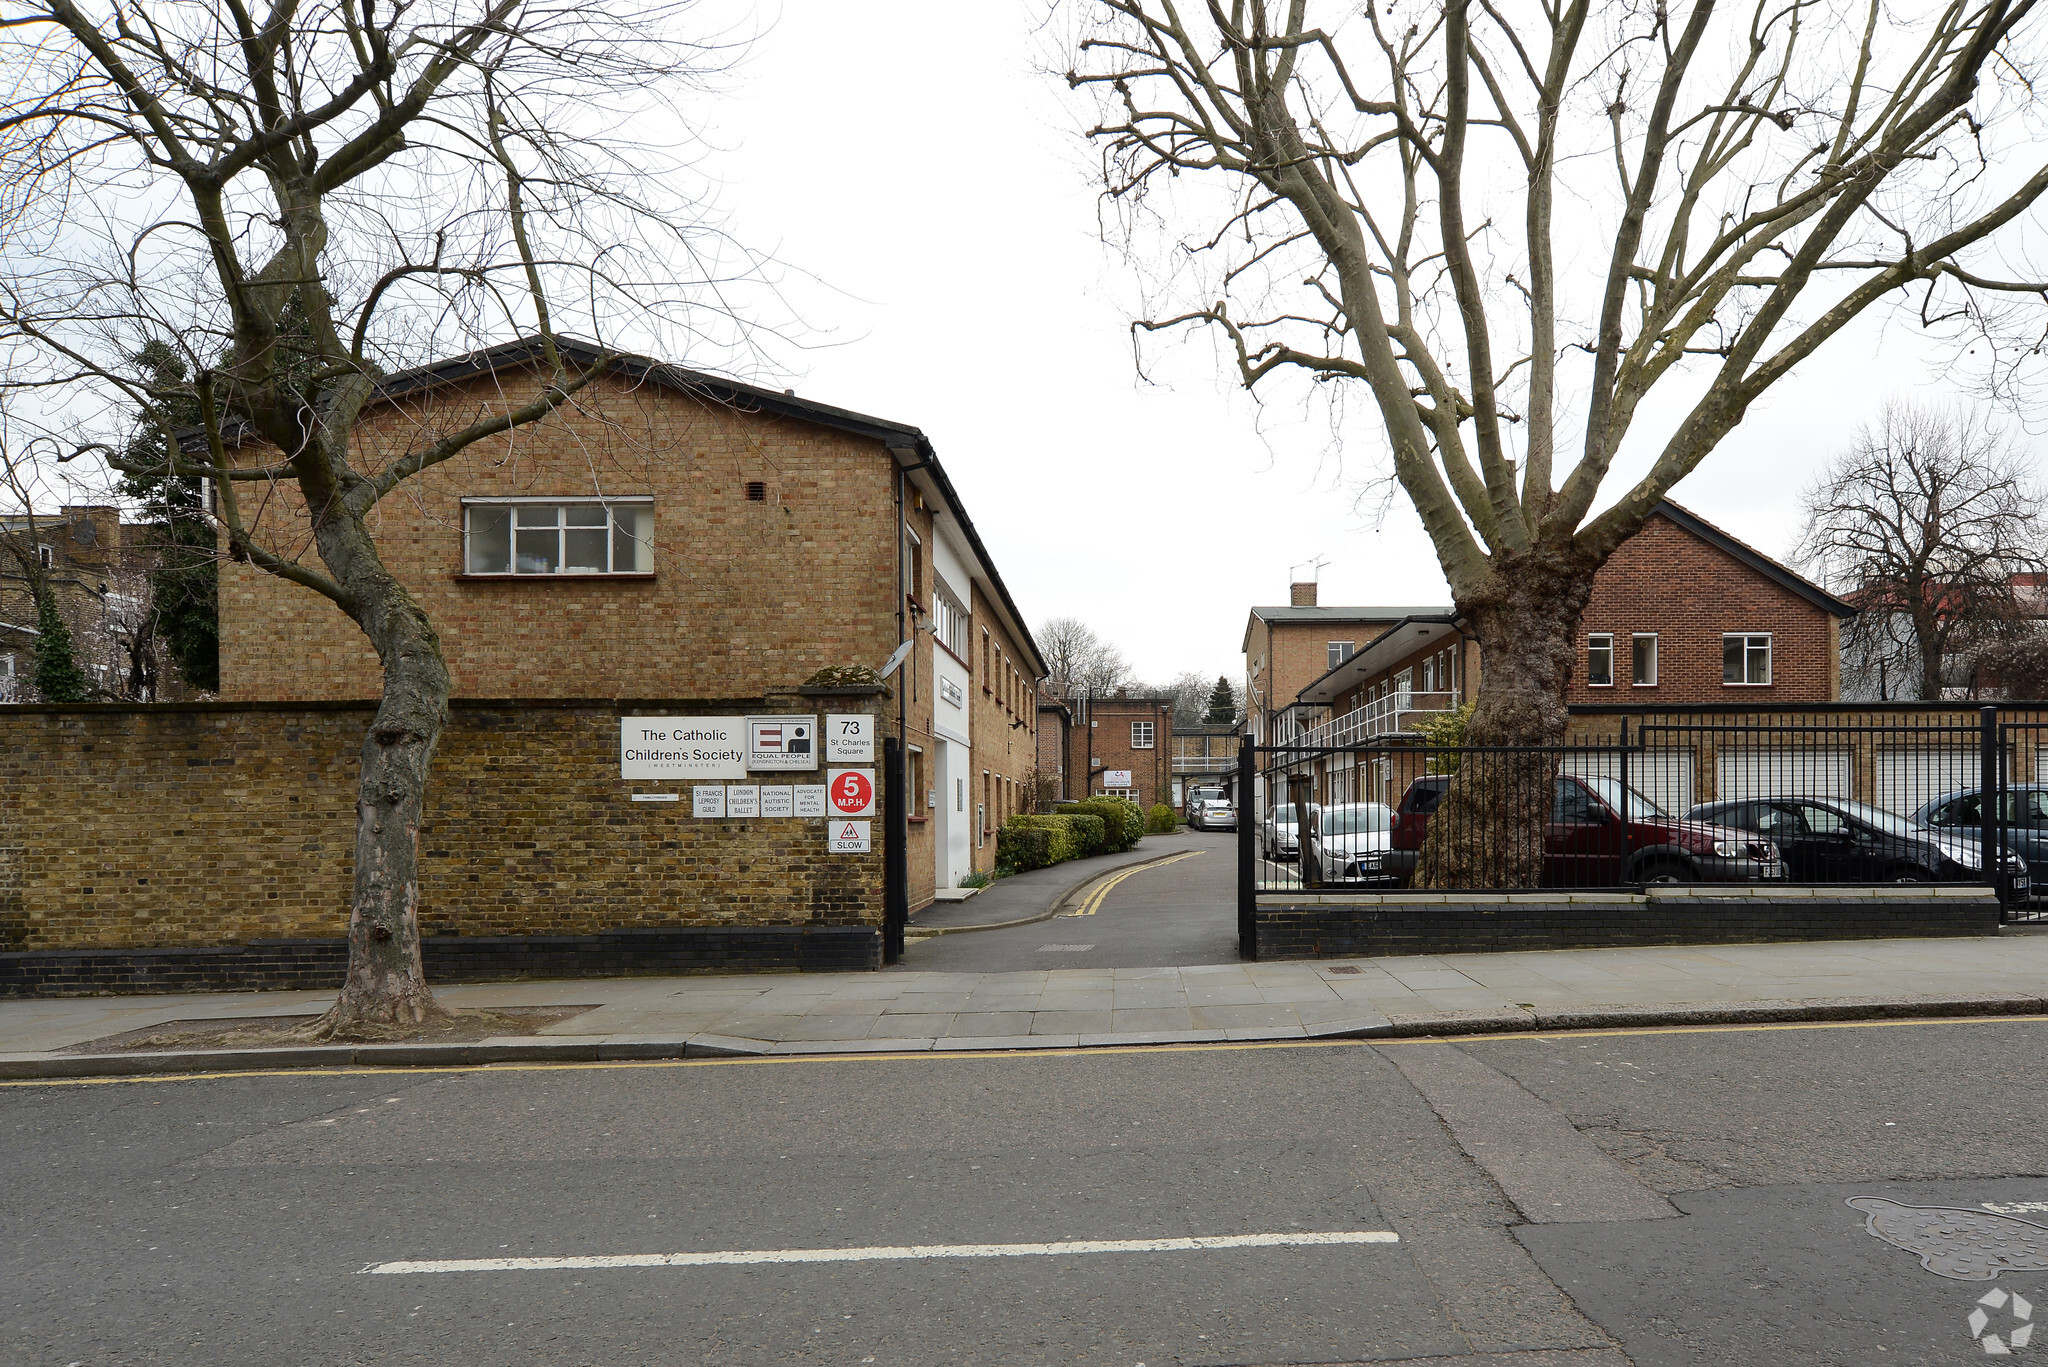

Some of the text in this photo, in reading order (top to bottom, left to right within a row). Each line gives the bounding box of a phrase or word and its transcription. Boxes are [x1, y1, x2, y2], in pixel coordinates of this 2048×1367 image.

[840, 721, 860, 735] 73
[641, 729, 727, 741] The Catholic
[625, 747, 743, 762] Children's Society
[843, 776, 860, 797] 5
[837, 798, 865, 807] M.P.H.
[837, 841, 863, 849] SLOW
